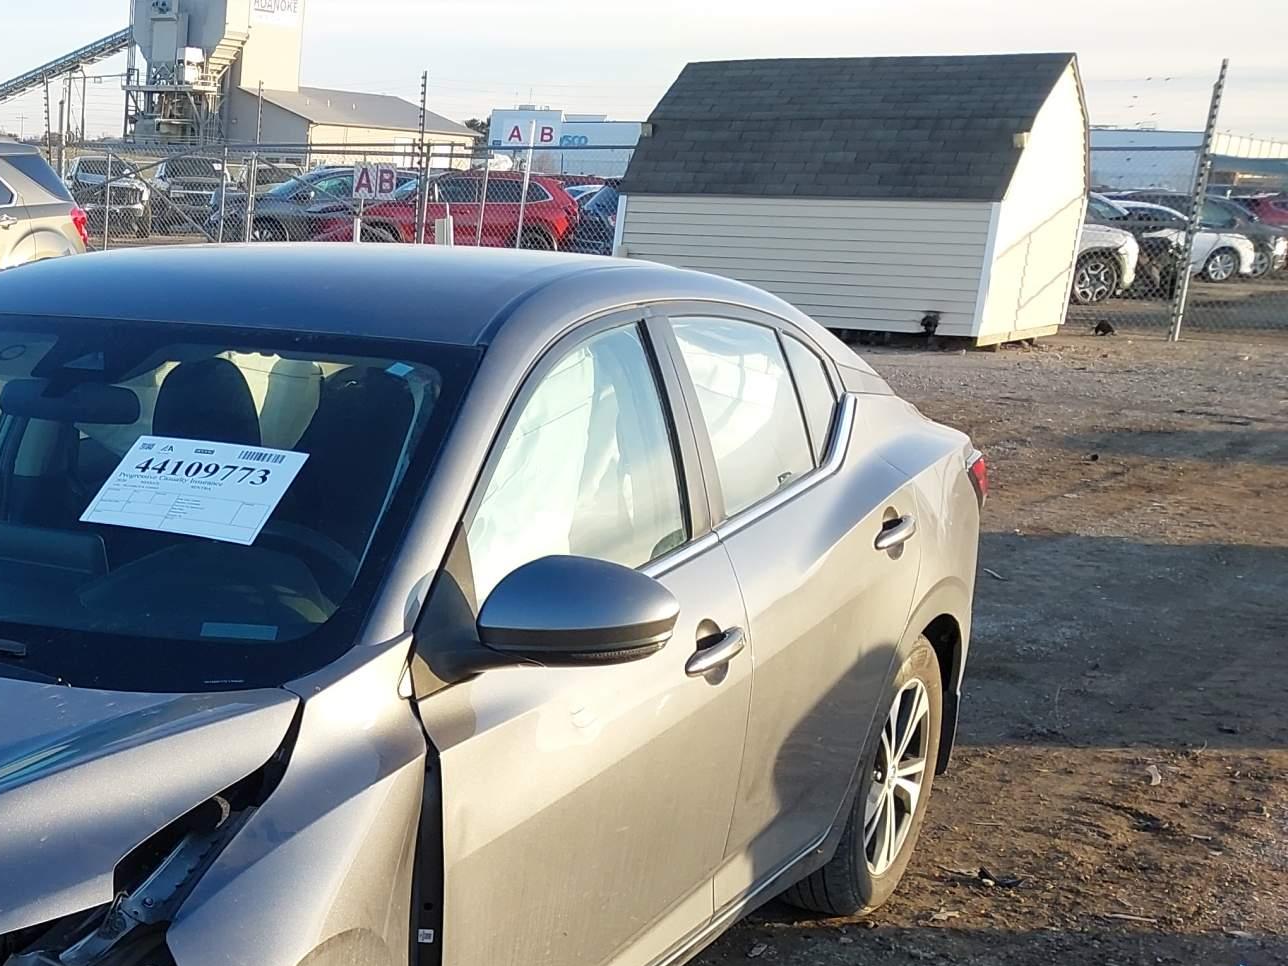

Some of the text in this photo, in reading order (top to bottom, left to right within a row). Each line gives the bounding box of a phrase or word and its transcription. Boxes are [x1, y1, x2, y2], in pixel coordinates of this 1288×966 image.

[508, 125, 554, 142] A B
[355, 167, 395, 194] A B
[118, 471, 158, 481] Progressive
[135, 457, 271, 486] 44109773
